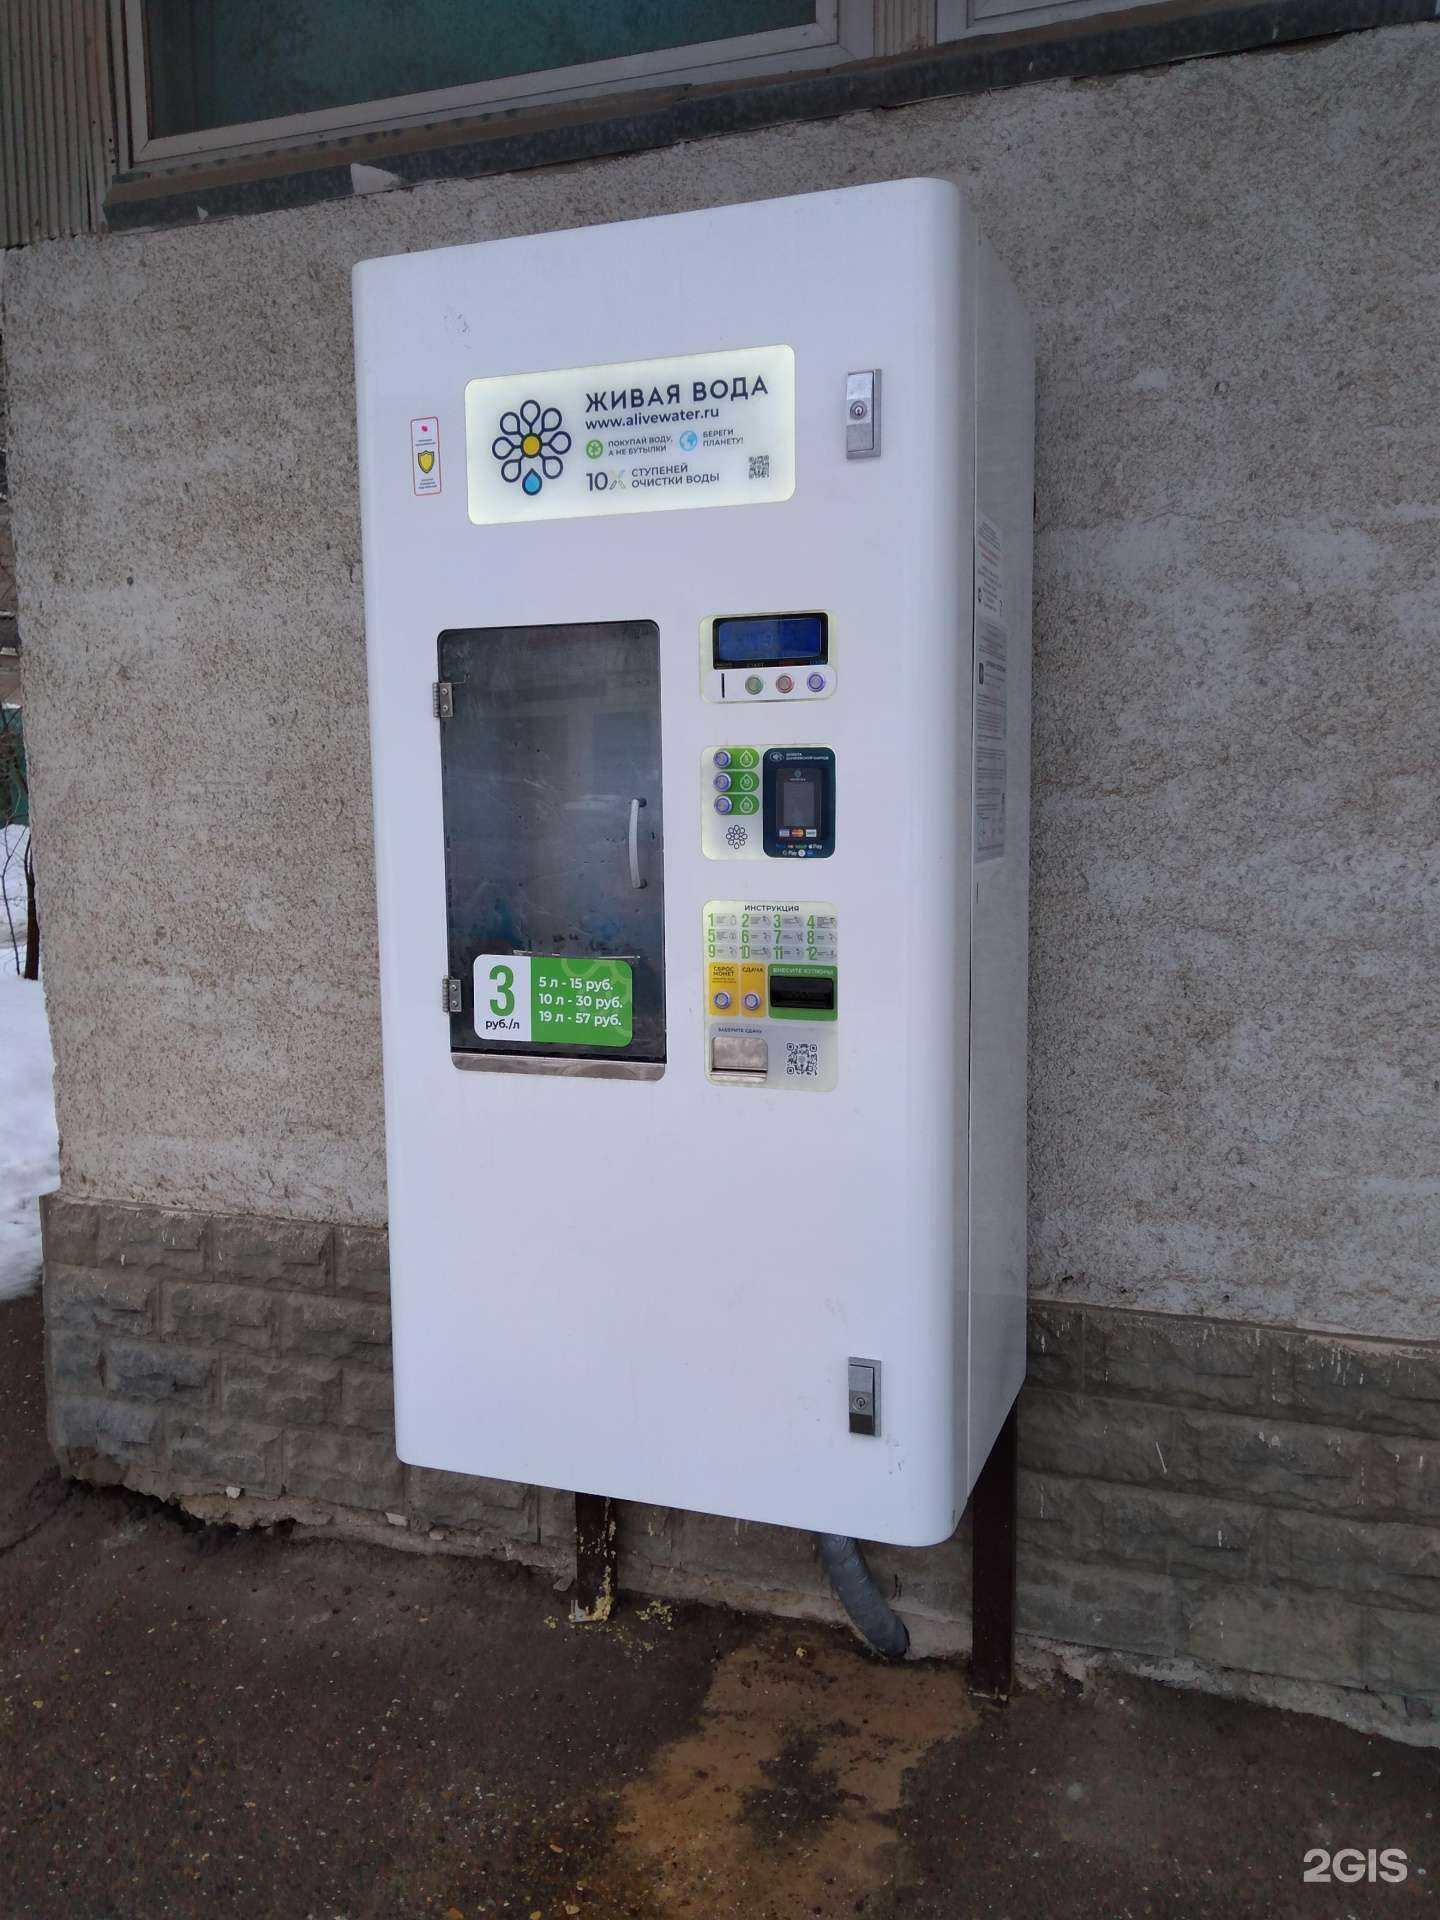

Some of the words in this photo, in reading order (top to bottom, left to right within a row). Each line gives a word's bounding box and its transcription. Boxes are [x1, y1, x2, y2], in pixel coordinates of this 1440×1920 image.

[586, 384, 680, 412] ЖИВАЯ
[692, 375, 768, 402] ВОДА
[586, 408, 720, 430] www.alivewater.ru
[703, 428, 734, 438] БЕРЕГИ
[608, 436, 647, 448] ПОКУПАЙ
[650, 435, 673, 444] ВОДУ,
[703, 437, 744, 447] ПЛАНЕТУ!
[616, 448, 626, 456] НЕ
[628, 445, 666, 455] БУТЫЛКИ
[632, 463, 688, 478] СТУПЕНЕЙ
[586, 472, 608, 492] 10
[632, 474, 682, 488] ОЧИСТКИ
[686, 473, 720, 484] ВОДЫ
[744, 904, 800, 912] ИНСТРУКЦИЯ
[708, 913, 714, 926] 1
[742, 914, 750, 927] 2
[773, 914, 781, 928] 3
[807, 915, 815, 929] 4
[708, 929, 715, 942] 5
[742, 930, 749, 943] 6
[773, 930, 781, 944] 7
[807, 931, 814, 944] 8
[708, 944, 716, 958] 9
[740, 945, 750, 959] 10
[773, 946, 783, 959] 11
[806, 947, 817, 960] 12
[488, 964, 515, 1017] 3
[539, 977, 547, 987] 5
[549, 980, 558, 988] л
[570, 978, 582, 989] 15
[586, 978, 614, 992] руб.
[539, 994, 552, 1005] 10
[555, 996, 564, 1006] л
[576, 996, 591, 1007] 30
[595, 997, 623, 1010] руб.
[485, 1018, 520, 1030] руб./л
[539, 1011, 552, 1022] 19
[555, 1014, 564, 1023] л
[576, 1013, 590, 1024] 57
[594, 1015, 622, 1028] руб.
